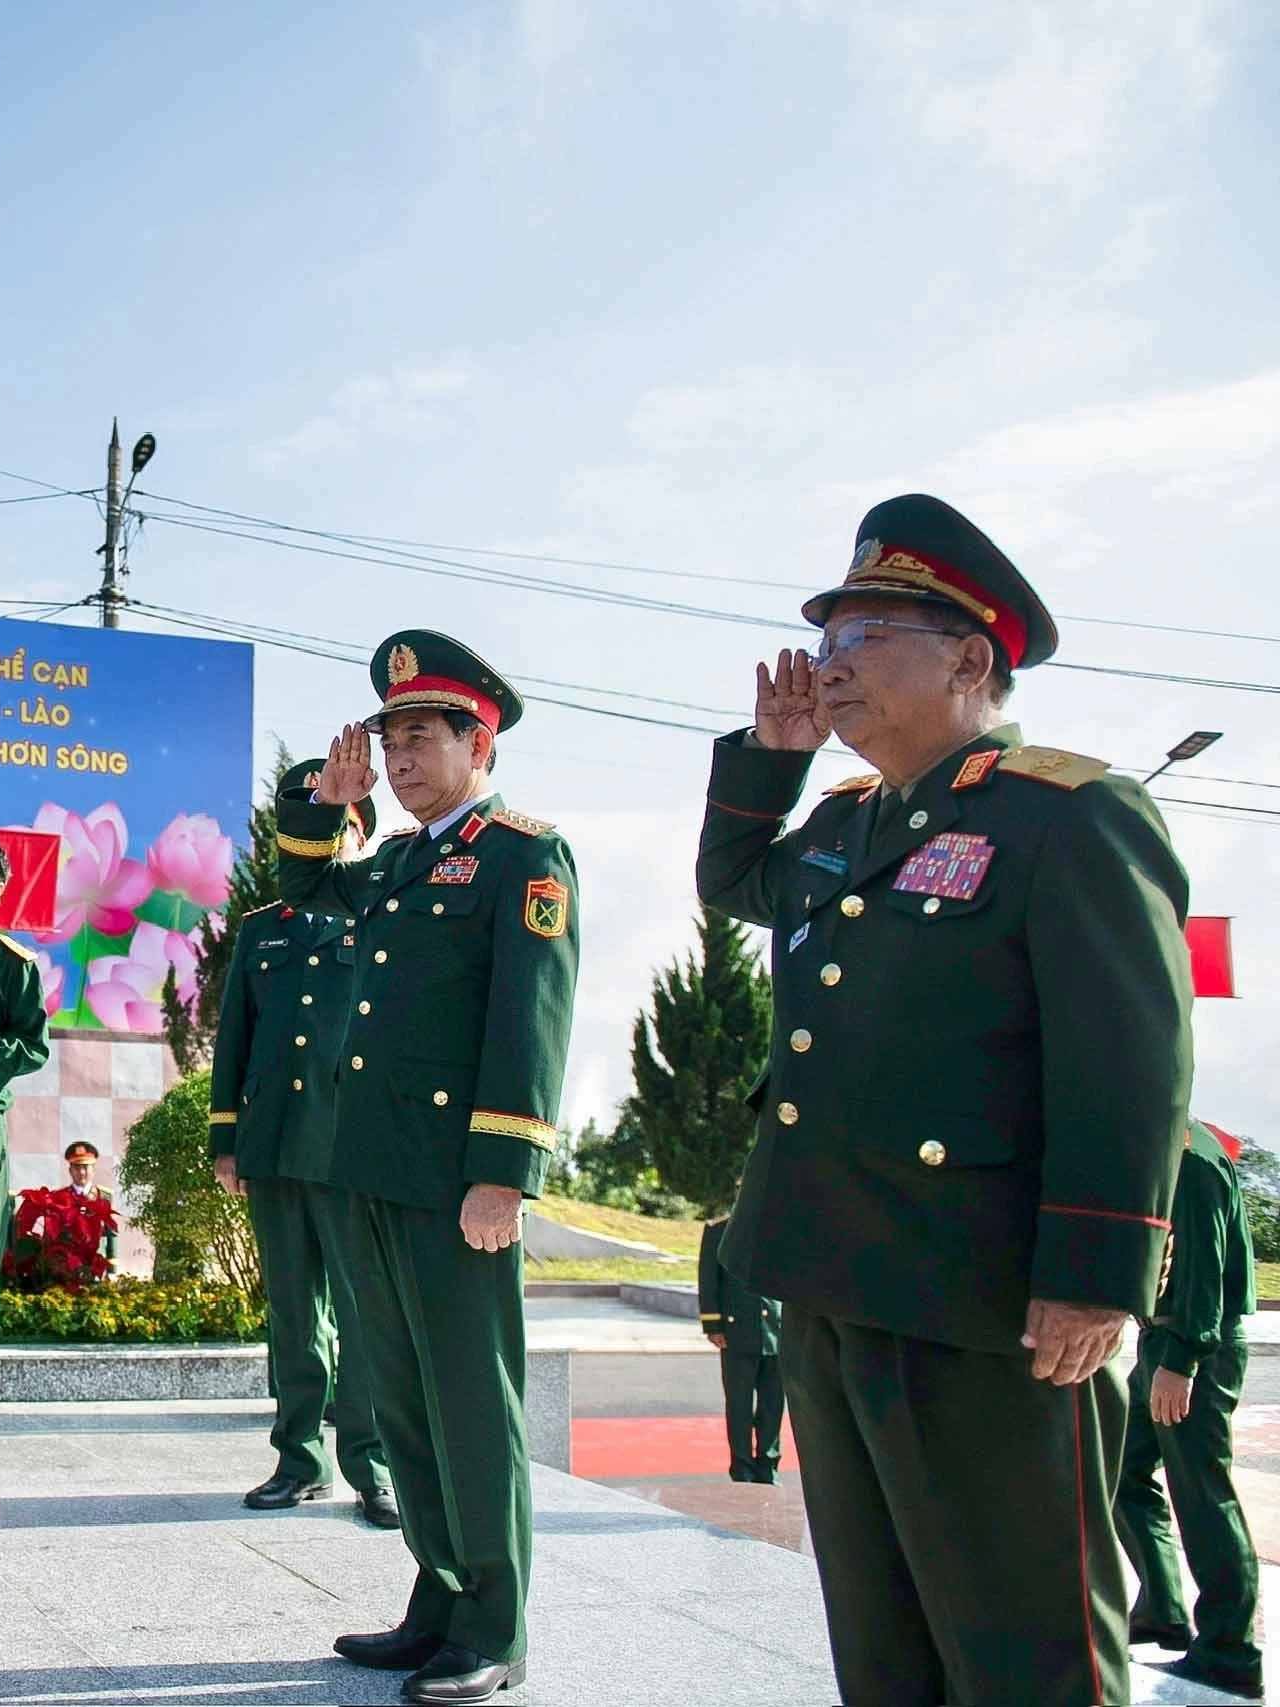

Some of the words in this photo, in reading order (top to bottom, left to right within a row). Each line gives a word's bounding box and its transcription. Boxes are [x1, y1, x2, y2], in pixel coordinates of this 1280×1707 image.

[31, 661, 89, 691] CẠN
[20, 697, 72, 728] LÀO
[56, 743, 130, 776] SÔNG
